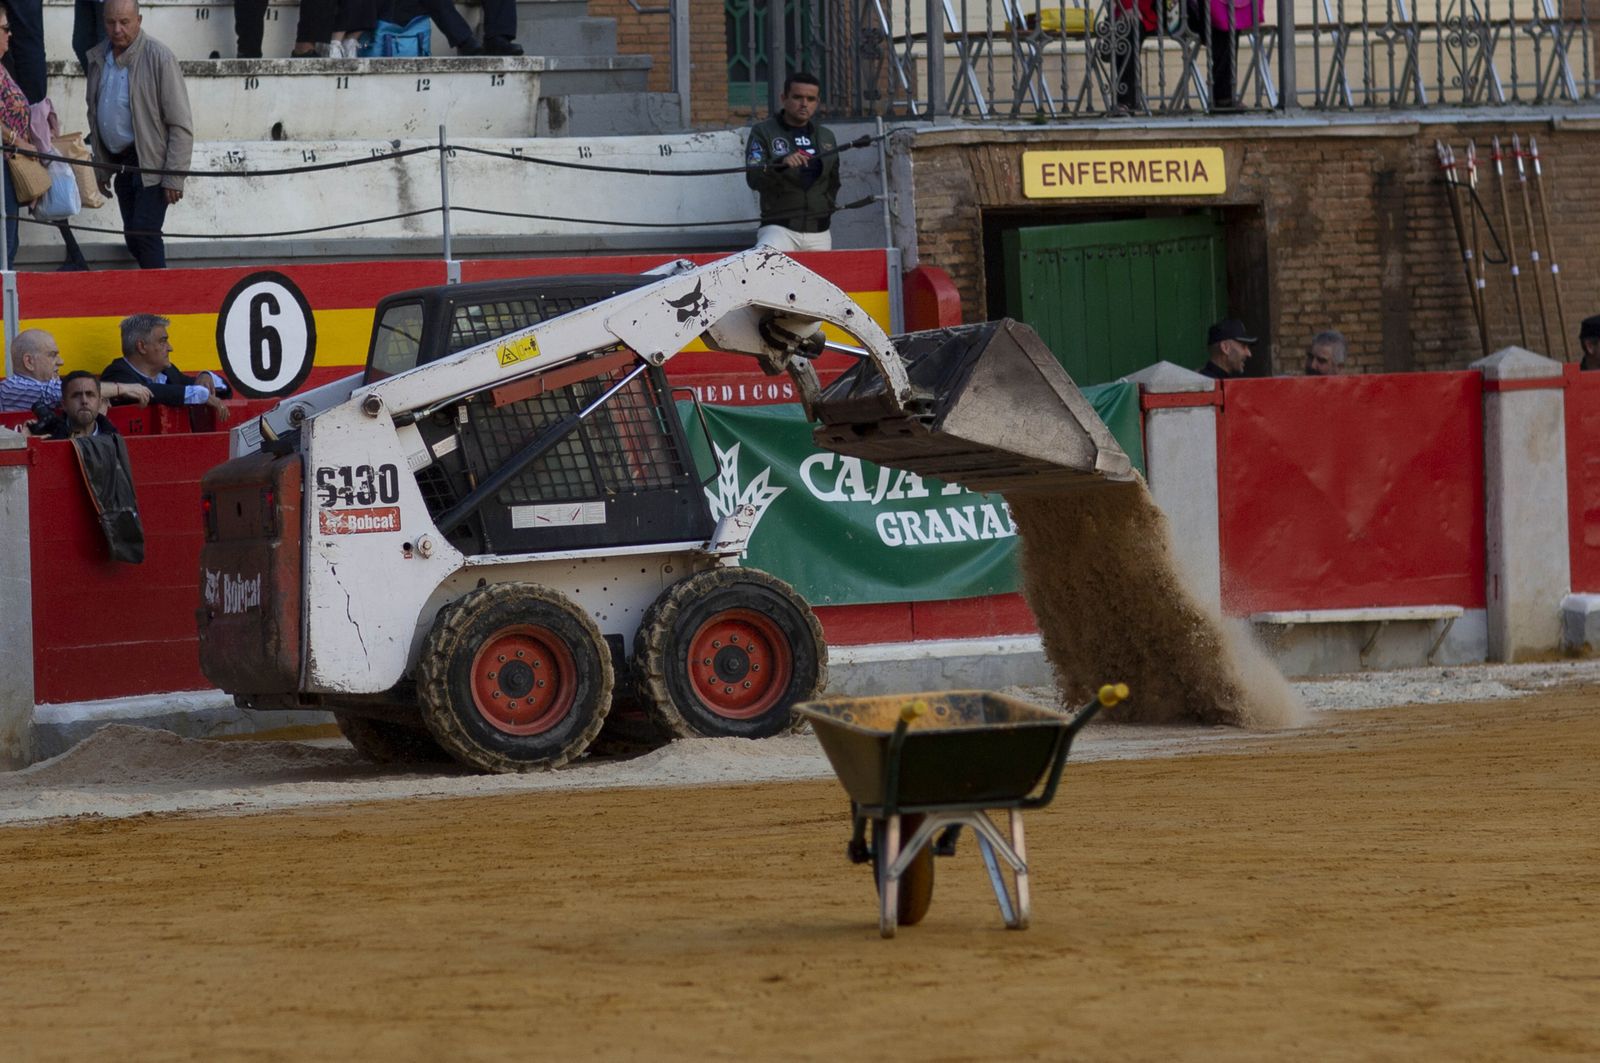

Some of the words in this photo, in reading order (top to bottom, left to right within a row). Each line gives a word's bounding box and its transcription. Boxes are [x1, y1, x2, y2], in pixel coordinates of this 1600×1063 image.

[195, 8, 209, 21] 10
[244, 77, 259, 90] 10
[336, 76, 349, 90] 11
[416, 78, 431, 92] 12
[490, 73, 505, 87] 13
[302, 149, 316, 163] 14
[577, 145, 592, 159] 18
[657, 143, 672, 157] 19
[1041, 159, 1209, 187] ENFERMERIA
[249, 291, 282, 382] 6
[316, 463, 400, 507] S130
[799, 452, 930, 506] CAJA
[347, 514, 394, 532] Bobcat
